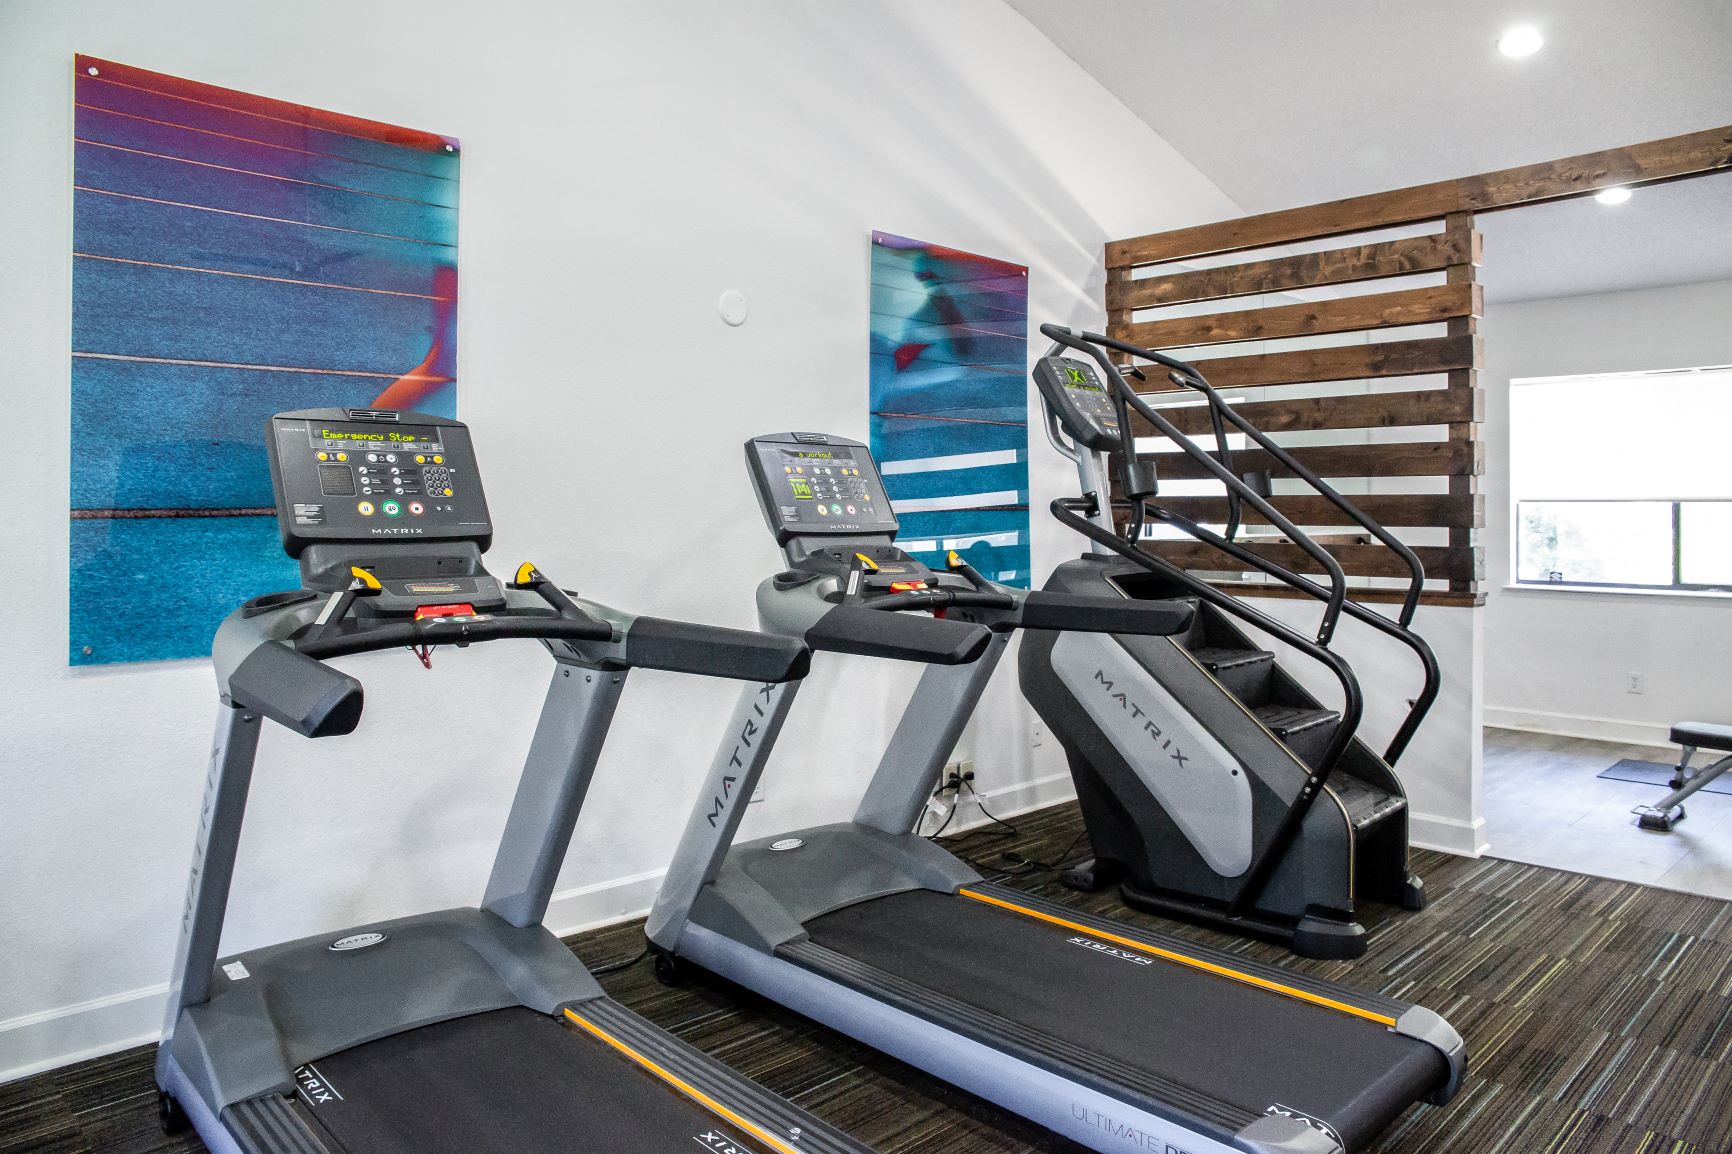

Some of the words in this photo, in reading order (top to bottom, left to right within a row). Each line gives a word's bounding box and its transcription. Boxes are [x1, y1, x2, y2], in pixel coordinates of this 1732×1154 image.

[322, 429, 384, 441] Emergency
[389, 432, 415, 442] Stop
[1094, 669, 1190, 769] MATRIX
[707, 682, 777, 829] MATRIX
[335, 934, 381, 946] MATRIX
[1069, 937, 1153, 964] MATRIX
[1071, 1103, 1160, 1153] ULTIMATE
